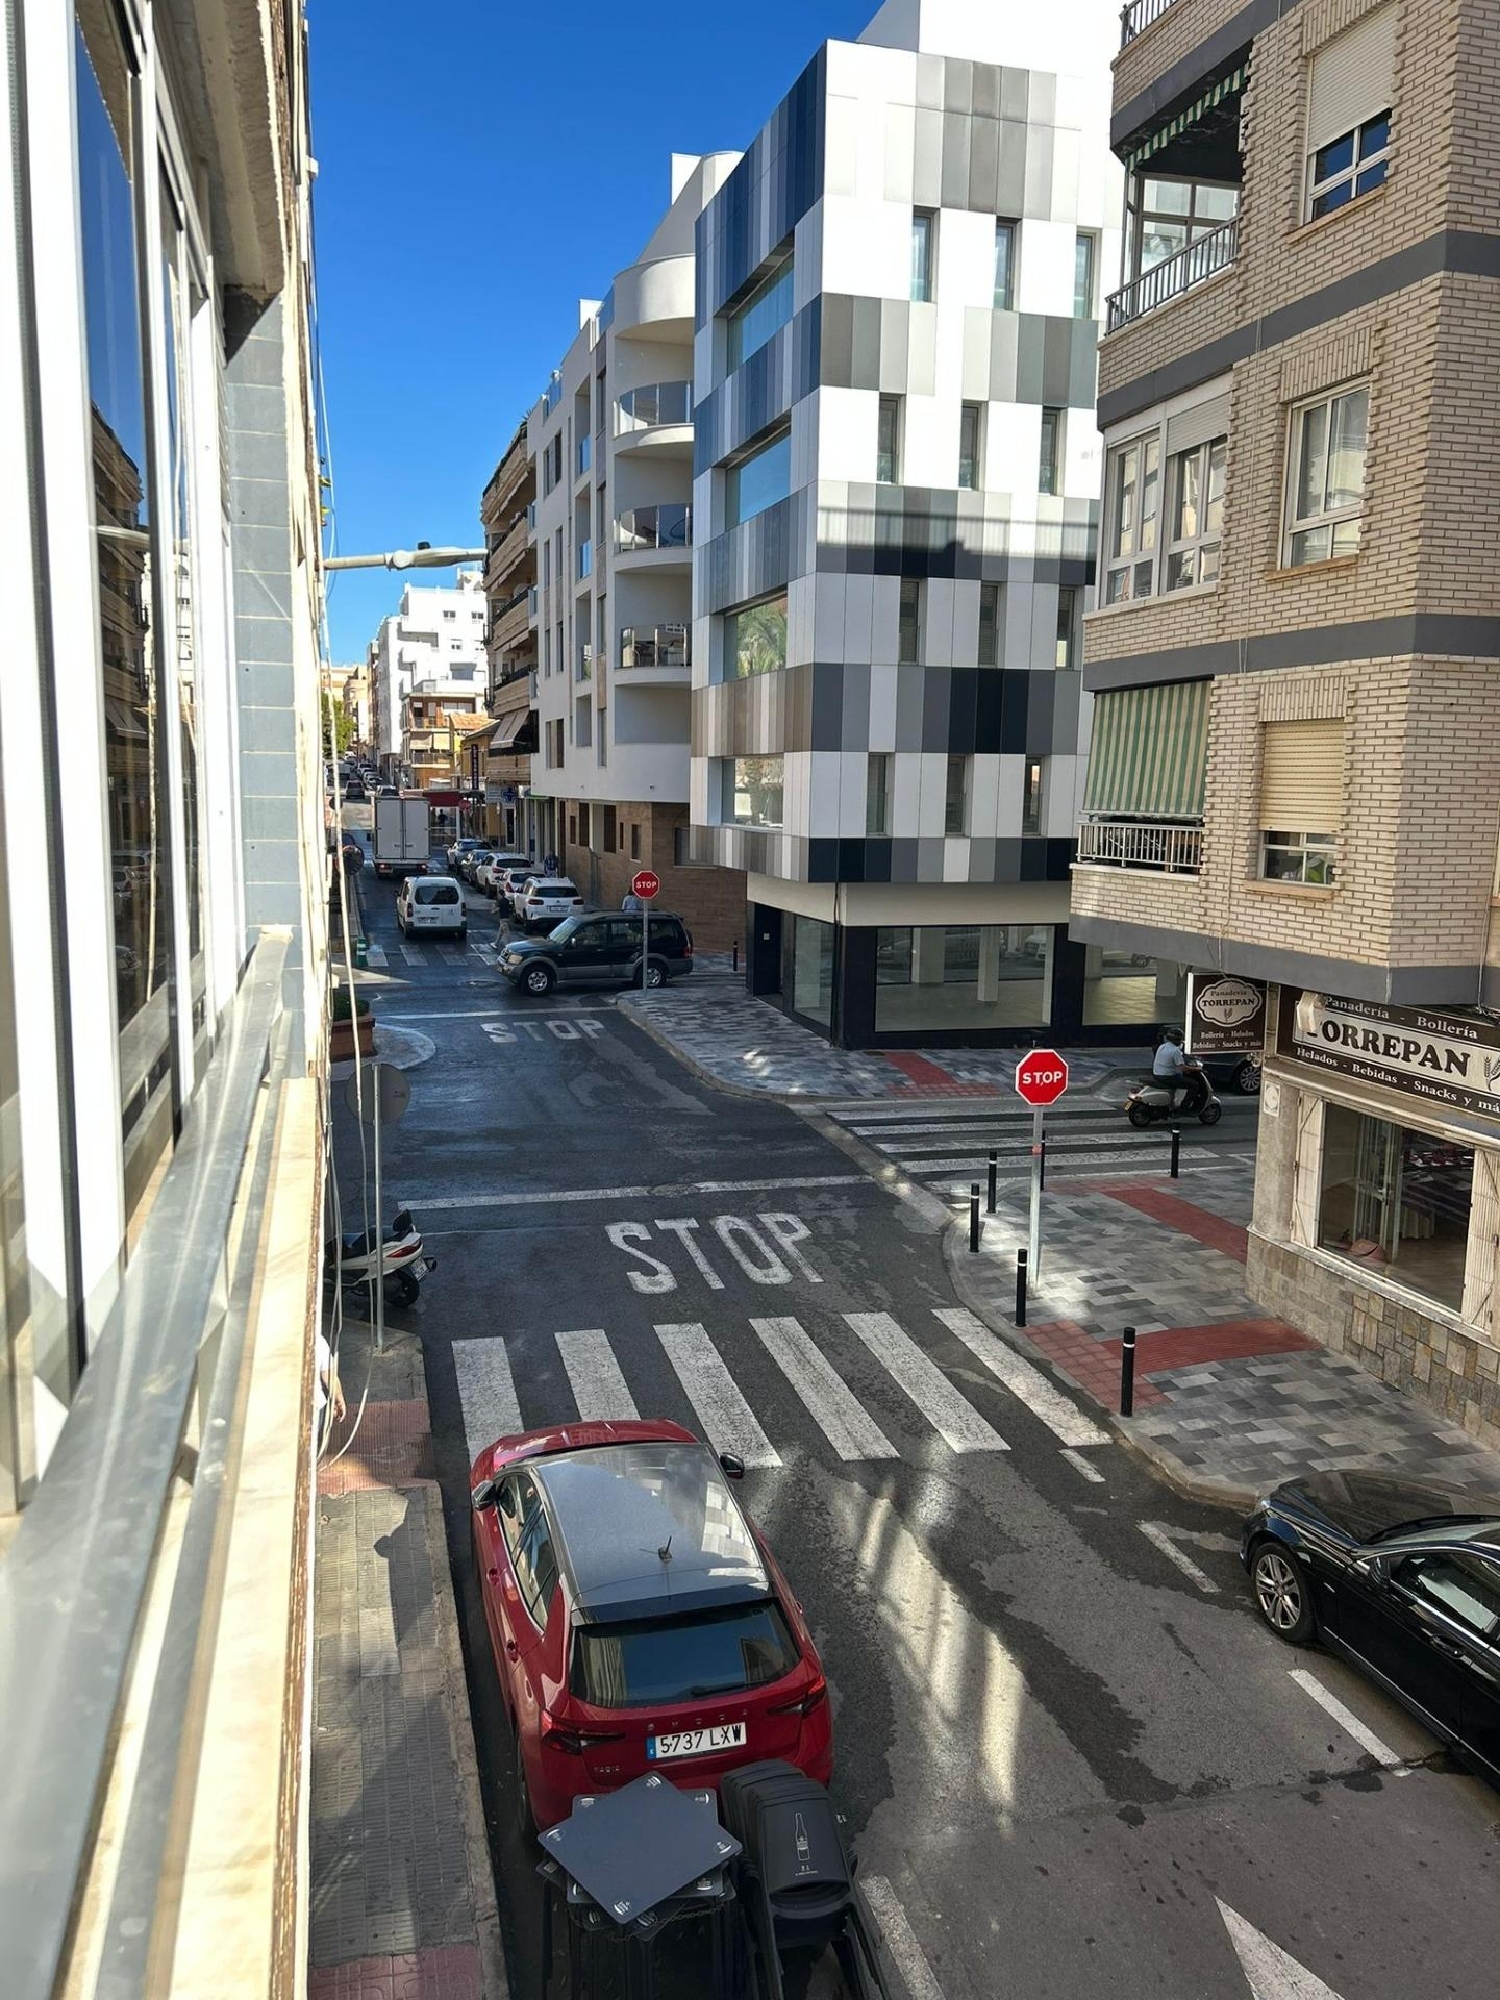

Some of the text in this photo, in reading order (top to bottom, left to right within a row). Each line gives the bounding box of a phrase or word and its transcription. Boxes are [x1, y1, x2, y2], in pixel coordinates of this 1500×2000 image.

[635, 881, 657, 889] STOP
[1202, 998, 1255, 1007] TORREPAN
[1325, 995, 1390, 1019] Panadería
[1416, 1016, 1478, 1039] Bollería
[480, 1019, 605, 1043] STOP
[1192, 1041, 1216, 1049] Bebidas
[1222, 1040, 1242, 1048] Snacks
[1307, 1019, 1471, 1078] ORREPAN
[1022, 1070, 1063, 1085] STOP
[1296, 1047, 1339, 1067] Helados
[1352, 1063, 1398, 1084] Bebidas
[1414, 1080, 1457, 1100] Snacks
[1464, 1096, 1472, 1106] y
[604, 1212, 825, 1295] STOP
[660, 1724, 742, 1753] 5737 LXW
